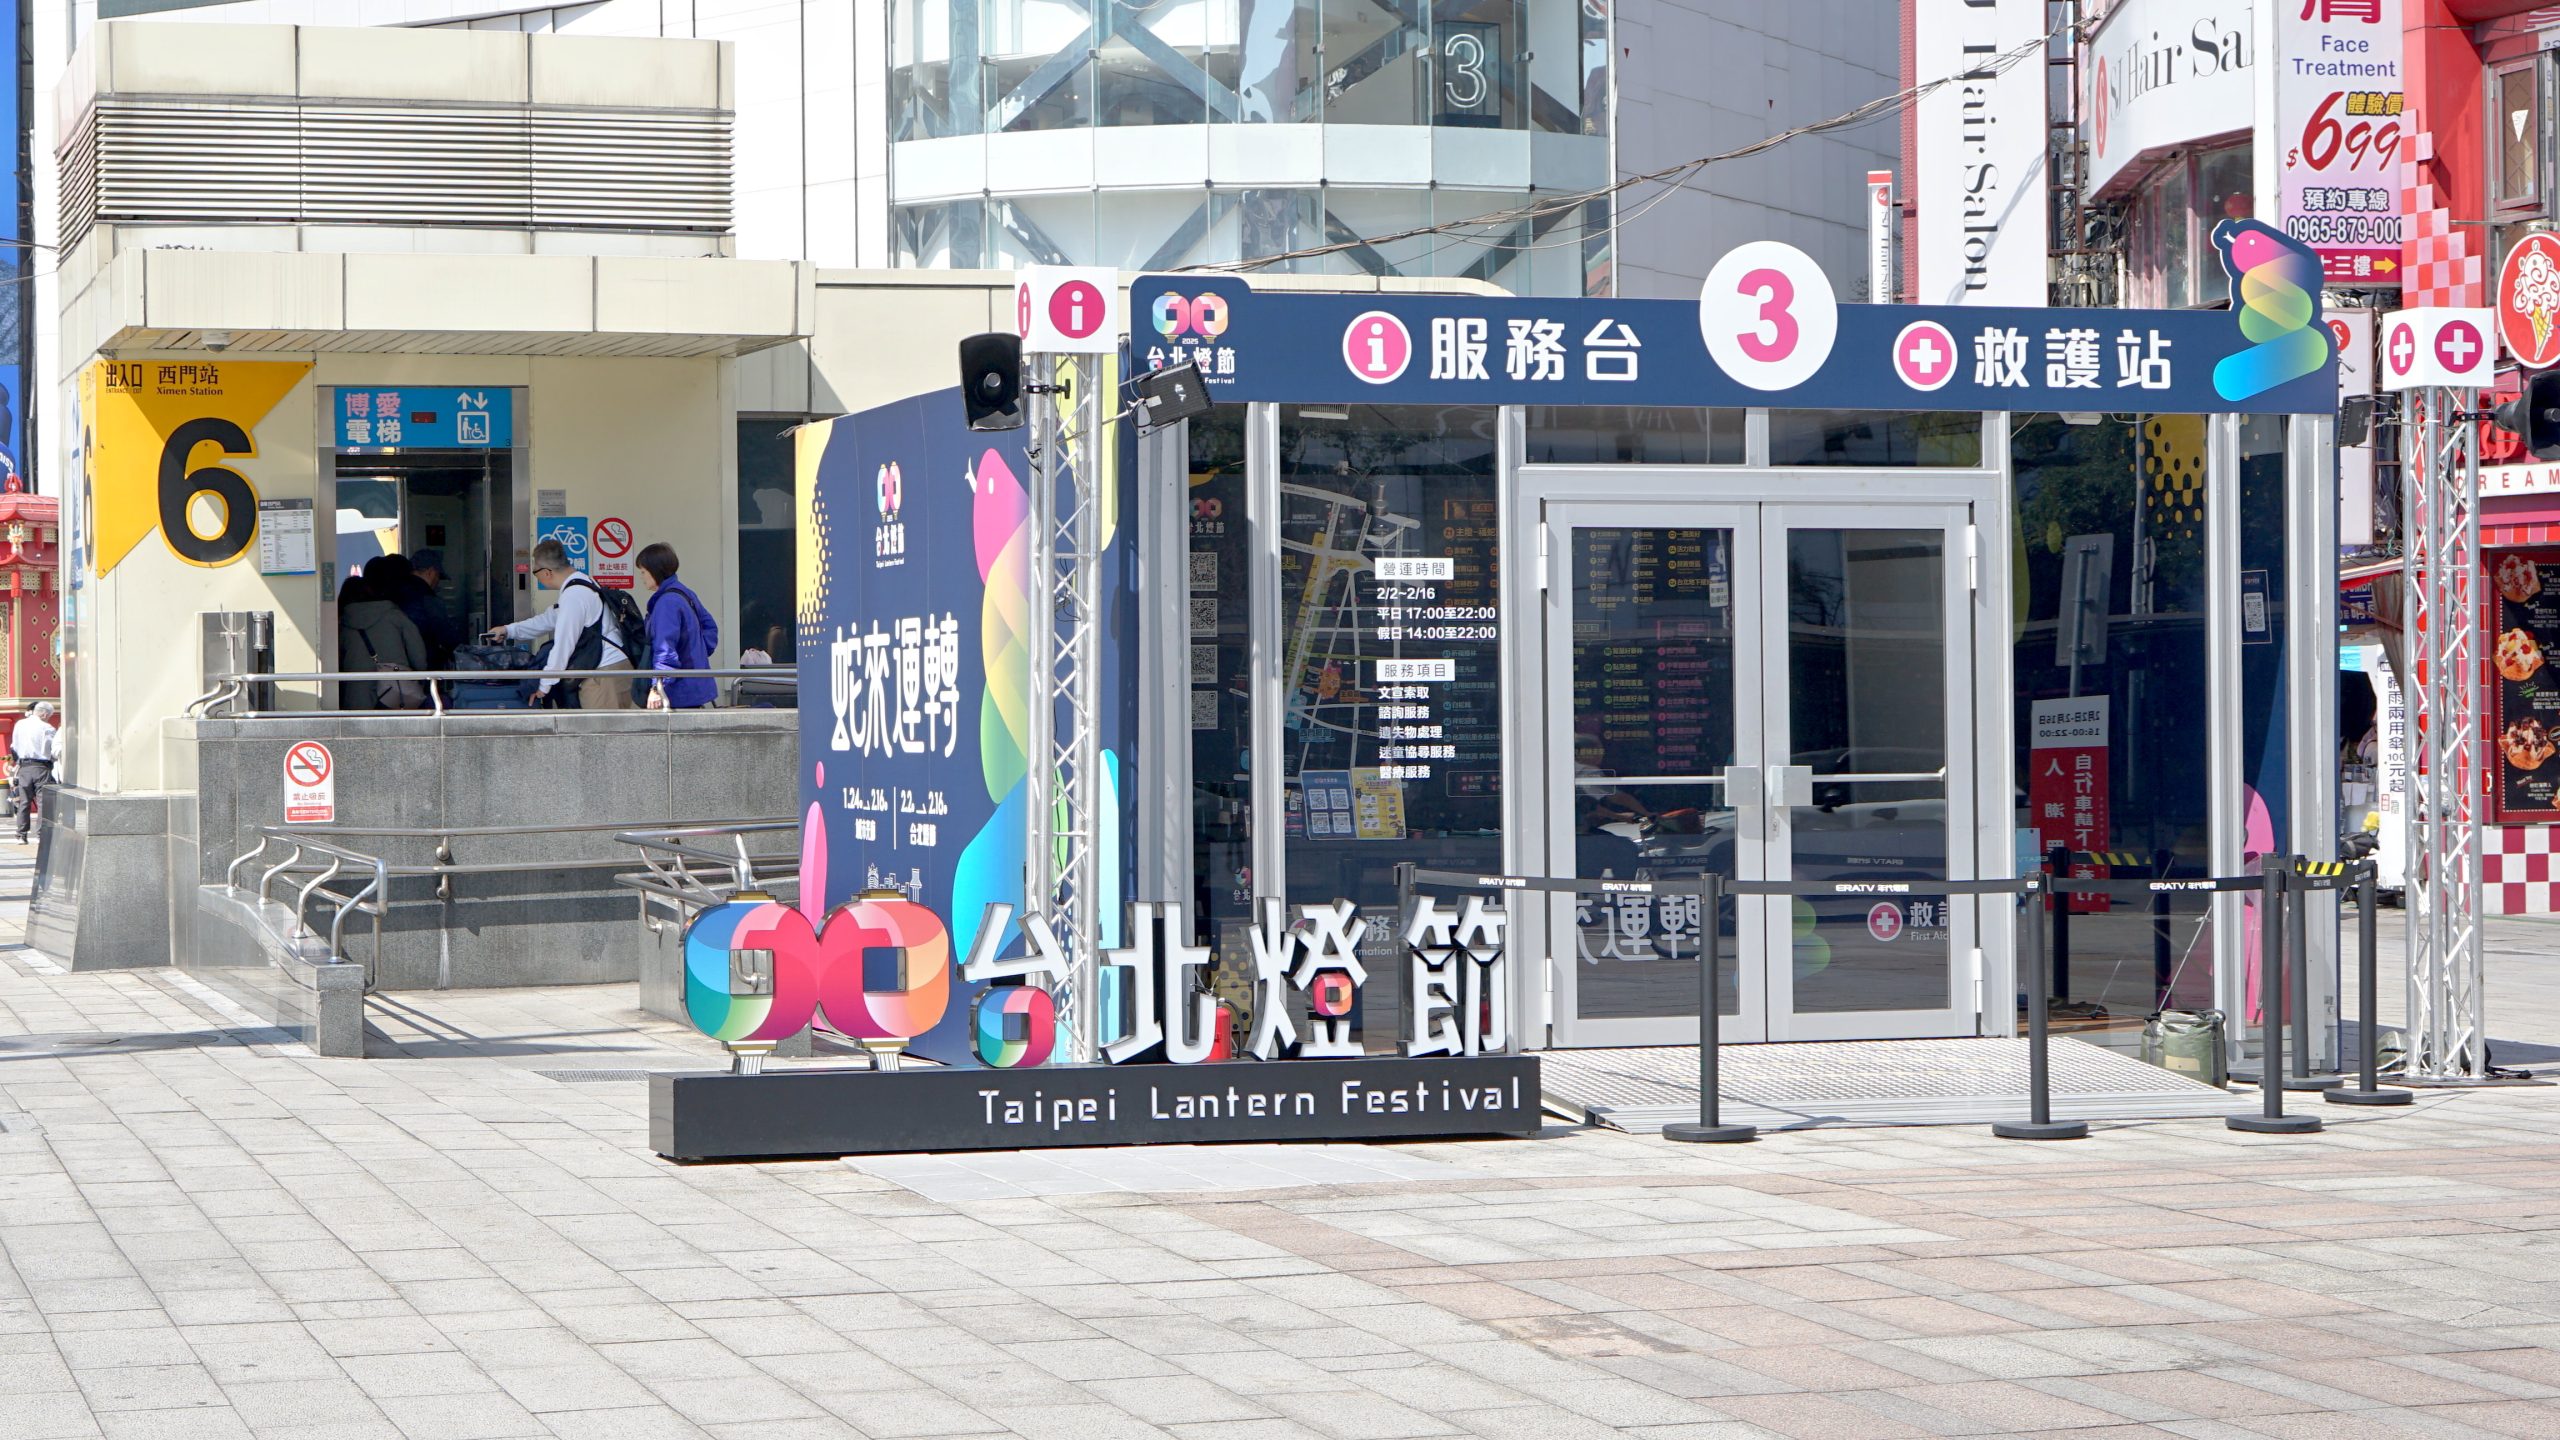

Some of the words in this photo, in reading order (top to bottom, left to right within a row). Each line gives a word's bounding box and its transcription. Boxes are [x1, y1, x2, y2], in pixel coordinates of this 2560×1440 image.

[2321, 35, 2370, 53] Face
[1445, 33, 1487, 109] 3
[2128, 31, 2183, 104] Hair
[2292, 58, 2397, 77] Treatment
[1962, 37, 1998, 155] Hair
[2346, 92, 2403, 116] 體驗價
[2303, 188, 2390, 211] 預約專線
[1962, 162, 2000, 293] Salon
[1736, 268, 1799, 362] 3
[1430, 317, 1642, 383] 服務台
[1974, 327, 2172, 390] 救護站
[106, 364, 143, 387] 出入口
[158, 366, 219, 385] 西門站
[157, 386, 187, 396] Ximen
[190, 386, 223, 396] Station
[345, 392, 401, 418] 博愛
[345, 419, 402, 444] 電梯
[158, 417, 257, 562] 6
[1383, 562, 1446, 576] 營運時間
[1377, 587, 1436, 600] 2/2~2/16
[1377, 607, 1401, 620] 平日
[1406, 607, 1496, 620] 17:00至22:00
[1377, 627, 1401, 640] 假日
[1407, 627, 1497, 640] 14:00至22:00
[1384, 664, 1446, 678] 服務項目
[831, 612, 960, 758] 蛇來運轉
[1378, 686, 1429, 700] 文宣索取
[1378, 706, 1430, 719] 諮詢服務
[1378, 726, 1443, 740] 遺失物處理
[1379, 765, 1431, 779] 醫療服務
[1479, 877, 1504, 886] ERATV
[1602, 883, 1629, 892] ERATV
[1835, 883, 1876, 892] ERATV
[2150, 881, 2186, 890] ERATV
[1911, 931, 1930, 941] First
[955, 895, 1507, 1068] 台北燈節
[978, 1088, 1117, 1131] Taipei
[1151, 1085, 1316, 1120] Lantern
[1341, 1076, 1520, 1115] Festival
